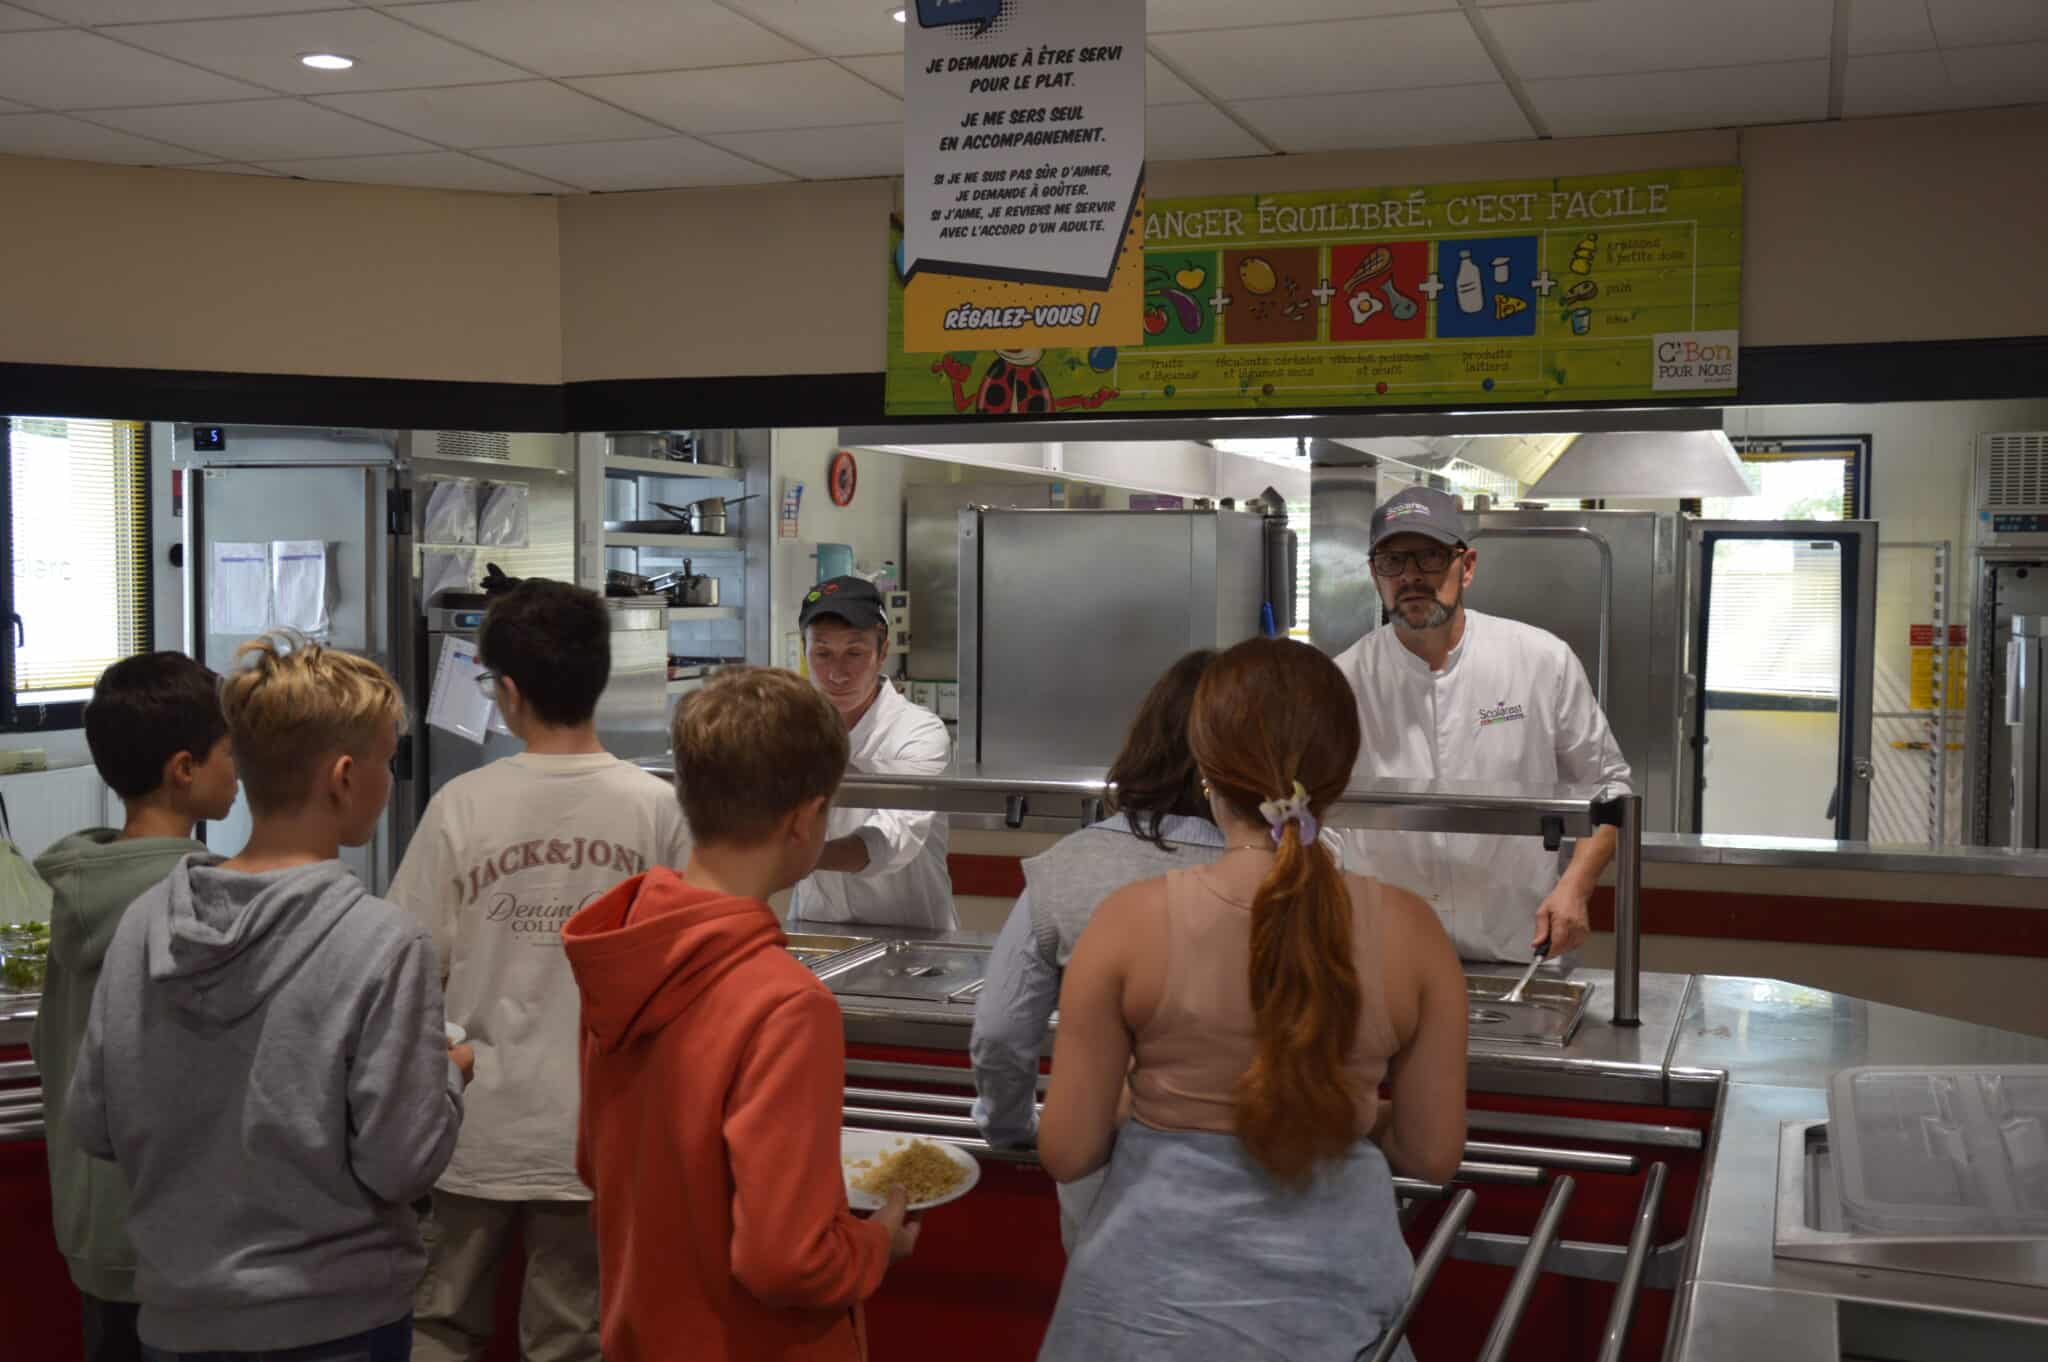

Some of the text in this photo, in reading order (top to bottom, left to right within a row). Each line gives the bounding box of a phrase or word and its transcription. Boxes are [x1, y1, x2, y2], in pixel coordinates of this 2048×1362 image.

[925, 45, 1123, 74] JE DEMANDE À ÊTRE SERVI
[970, 72, 1076, 93] POUR LE PLAT.
[961, 106, 1083, 127] JE ME SERS SEUL
[939, 127, 1106, 151] EN ACCOMPAGNEMENT.
[933, 174, 944, 185] SI
[947, 173, 960, 184] JE
[963, 172, 978, 183] NE
[982, 170, 1006, 182] SUIS
[1009, 168, 1032, 181] PAS
[1035, 163, 1058, 179] SÛR
[955, 181, 1089, 202] JE DEMANDE À GOÛTER.
[931, 201, 1116, 221] SI J'AIME, JE REVIENS ME SERVIR
[1144, 184, 1670, 240] ANGER ÉQUILIBRÉ, C'EST FACILE
[939, 220, 1105, 239] AVEC L'ACCORD D'UN ADULTE.
[943, 304, 1100, 331] RÉGALEZ-VOUS !
[1658, 363, 1733, 379] POUR NOUS
[511, 918, 564, 934] COLL
